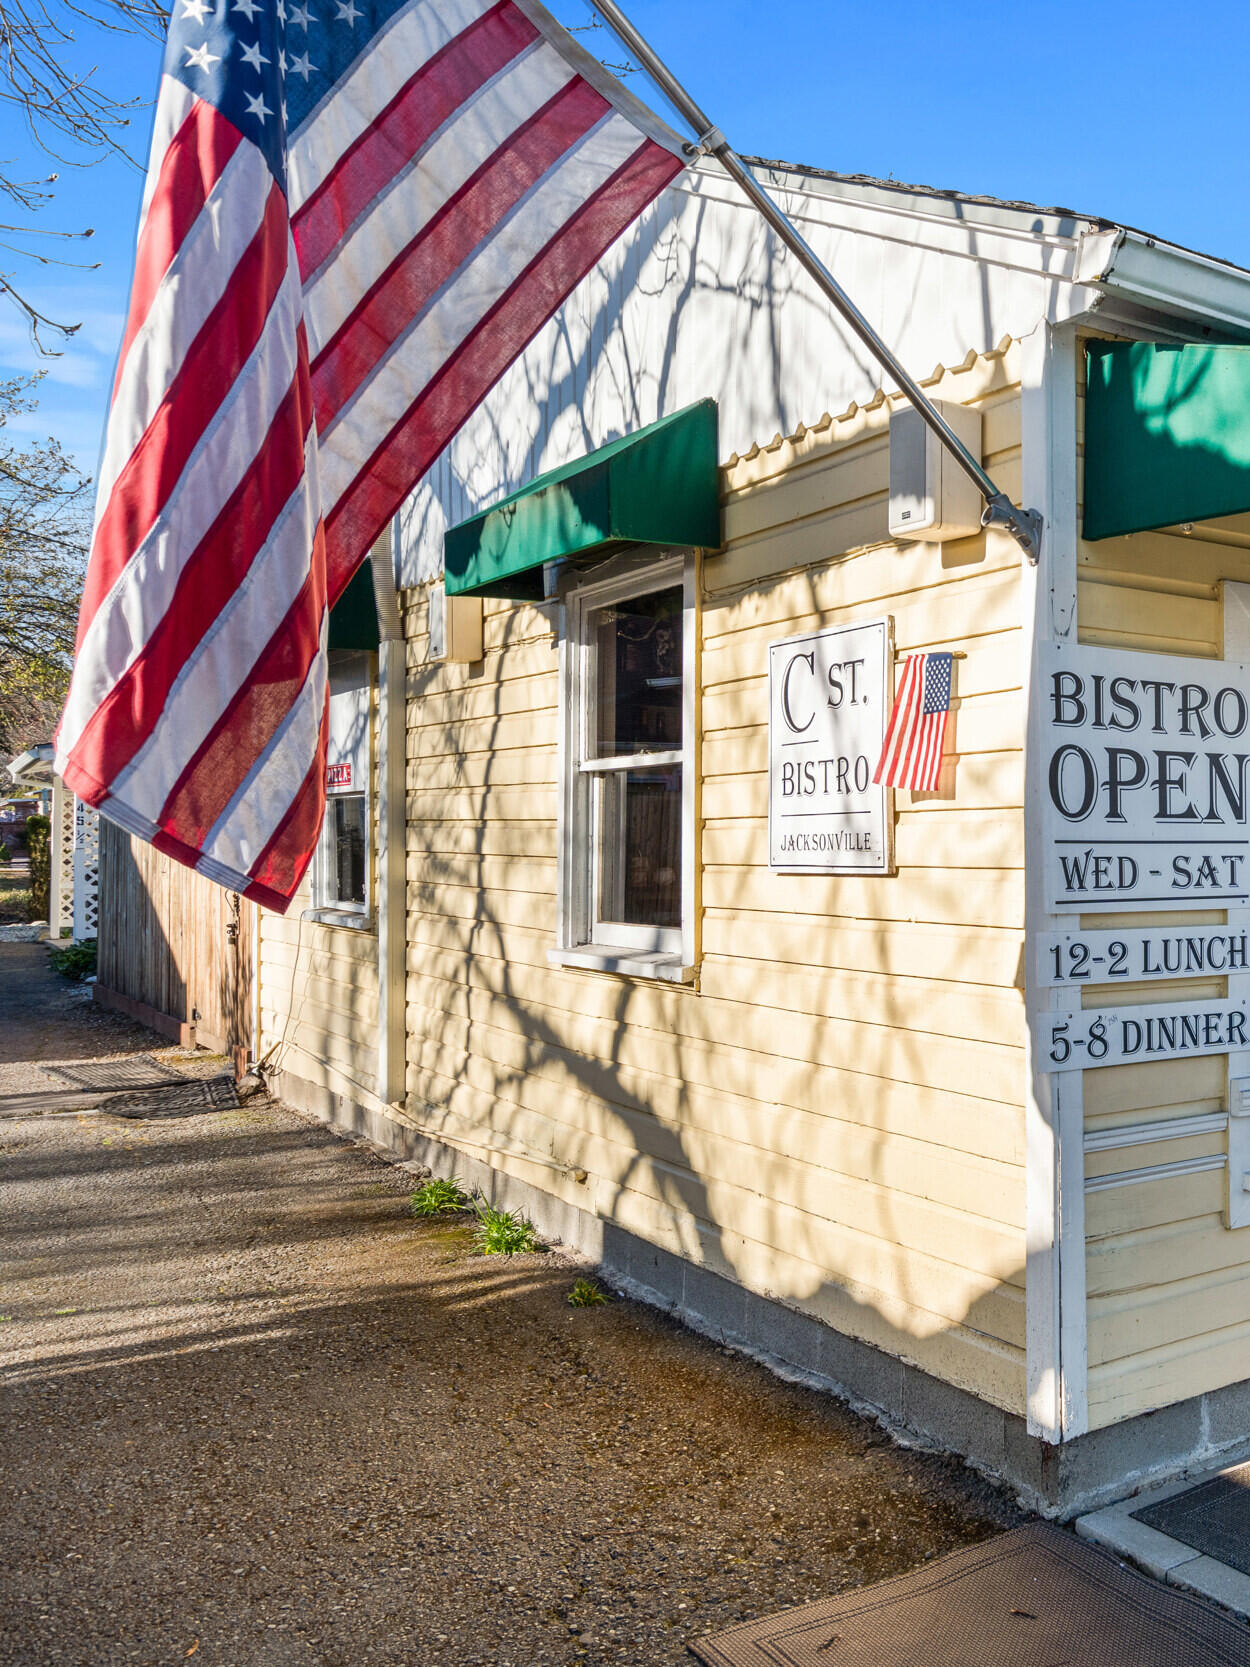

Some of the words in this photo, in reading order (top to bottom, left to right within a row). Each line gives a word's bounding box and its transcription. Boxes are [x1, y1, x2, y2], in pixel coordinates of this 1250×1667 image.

[781, 651, 816, 734] C
[827, 658, 868, 709] ST.
[1049, 670, 1249, 742] BISTRO
[781, 755, 870, 797] BISTRO
[1048, 743, 1250, 825] OPEN
[780, 831, 871, 852] JACKSONVILLE
[1058, 847, 1139, 893] WED
[1171, 855, 1245, 890] SAT
[1048, 942, 1131, 982] 12-2
[1141, 935, 1250, 976] LUNCH
[1048, 1014, 1111, 1064] 5-8
[1121, 1011, 1250, 1056] DINNER
